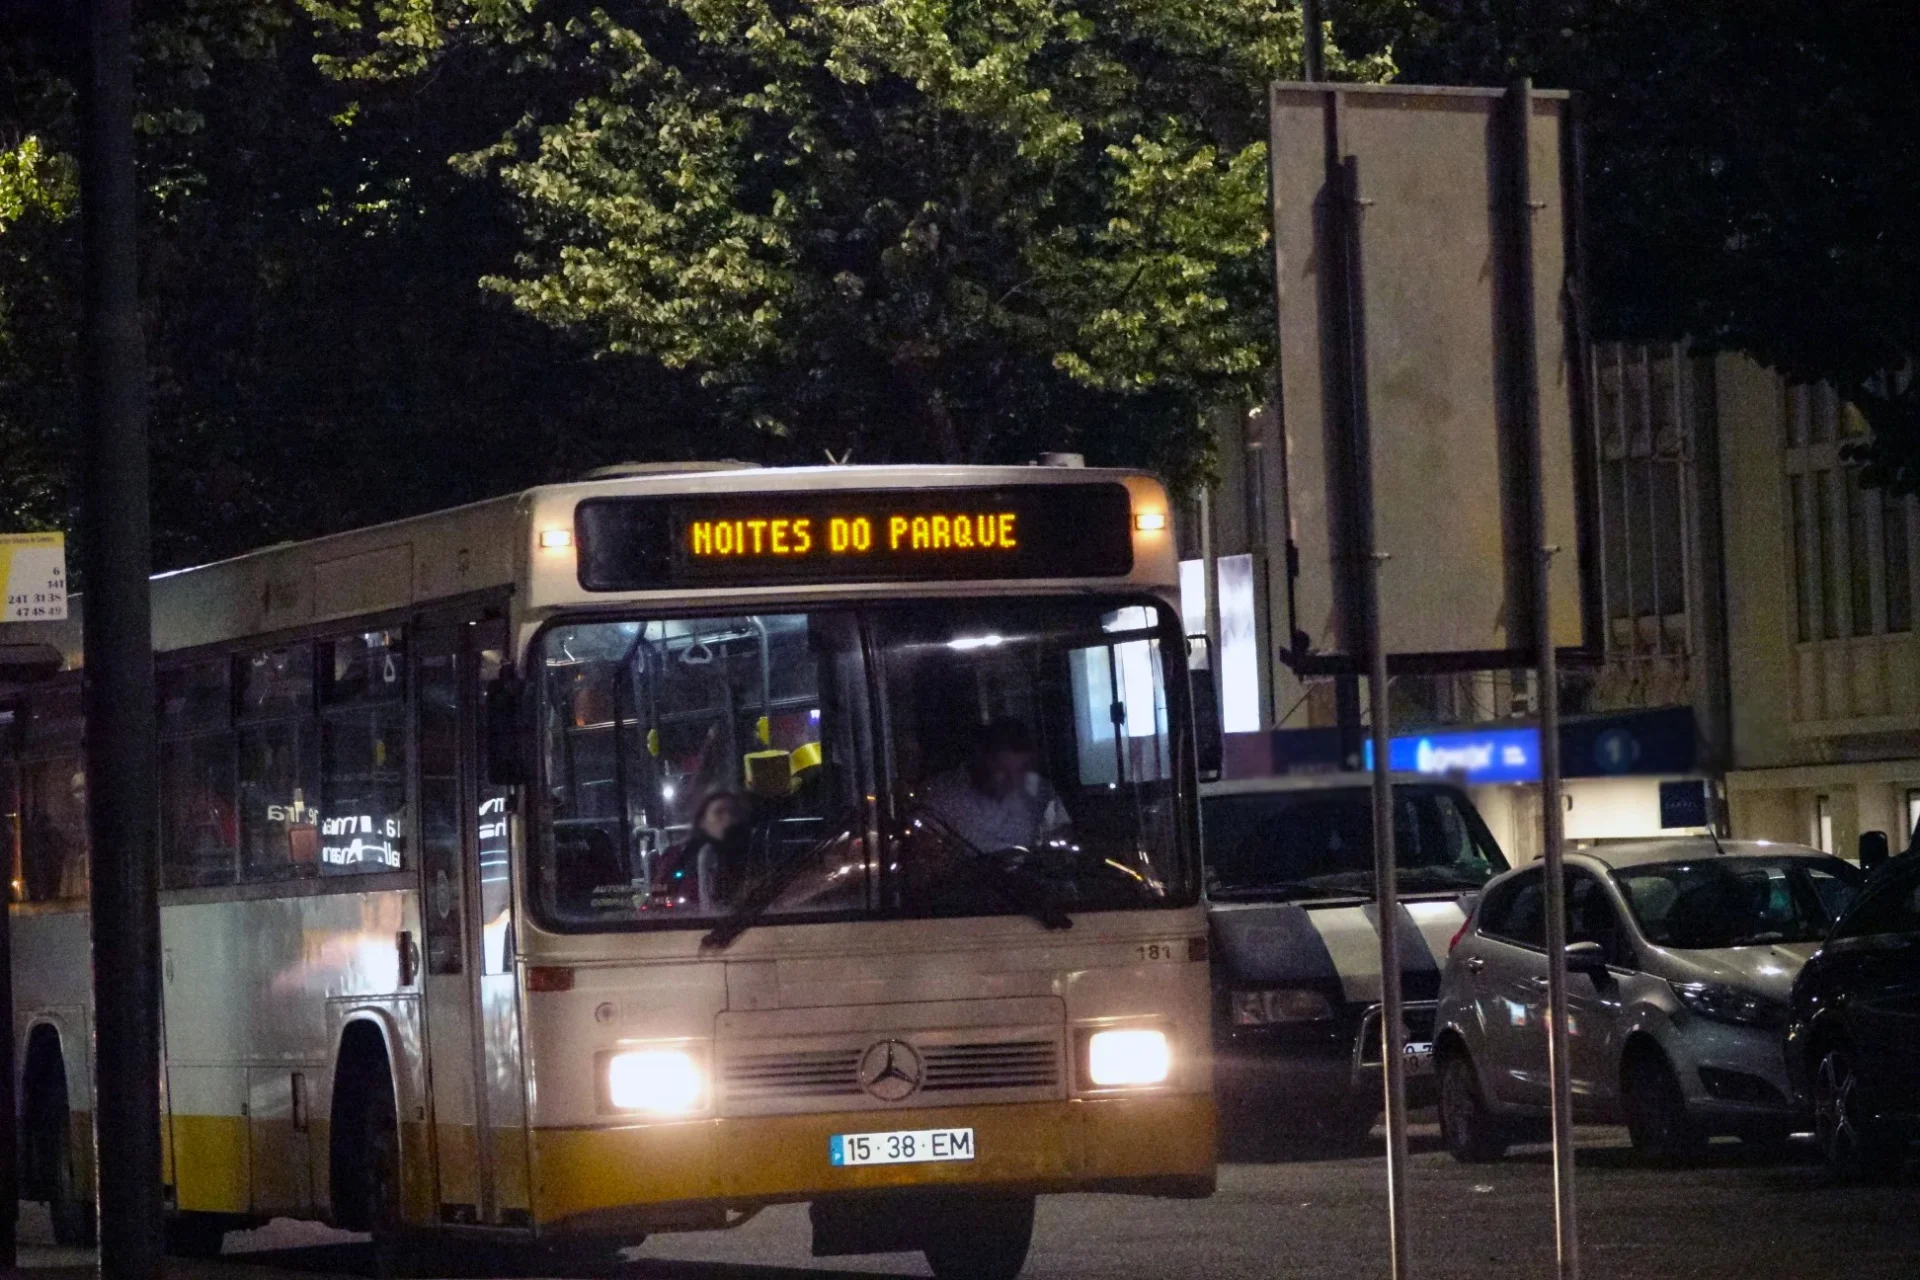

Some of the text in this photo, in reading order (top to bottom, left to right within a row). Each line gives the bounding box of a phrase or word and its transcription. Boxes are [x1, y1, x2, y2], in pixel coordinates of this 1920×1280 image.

[692, 513, 1017, 554] NOITES DO PARQUE
[53, 567, 60, 576] 6
[33, 593, 46, 603] 31
[16, 607, 30, 617] 47
[48, 606, 62, 616] 49
[1136, 944, 1171, 960] 181
